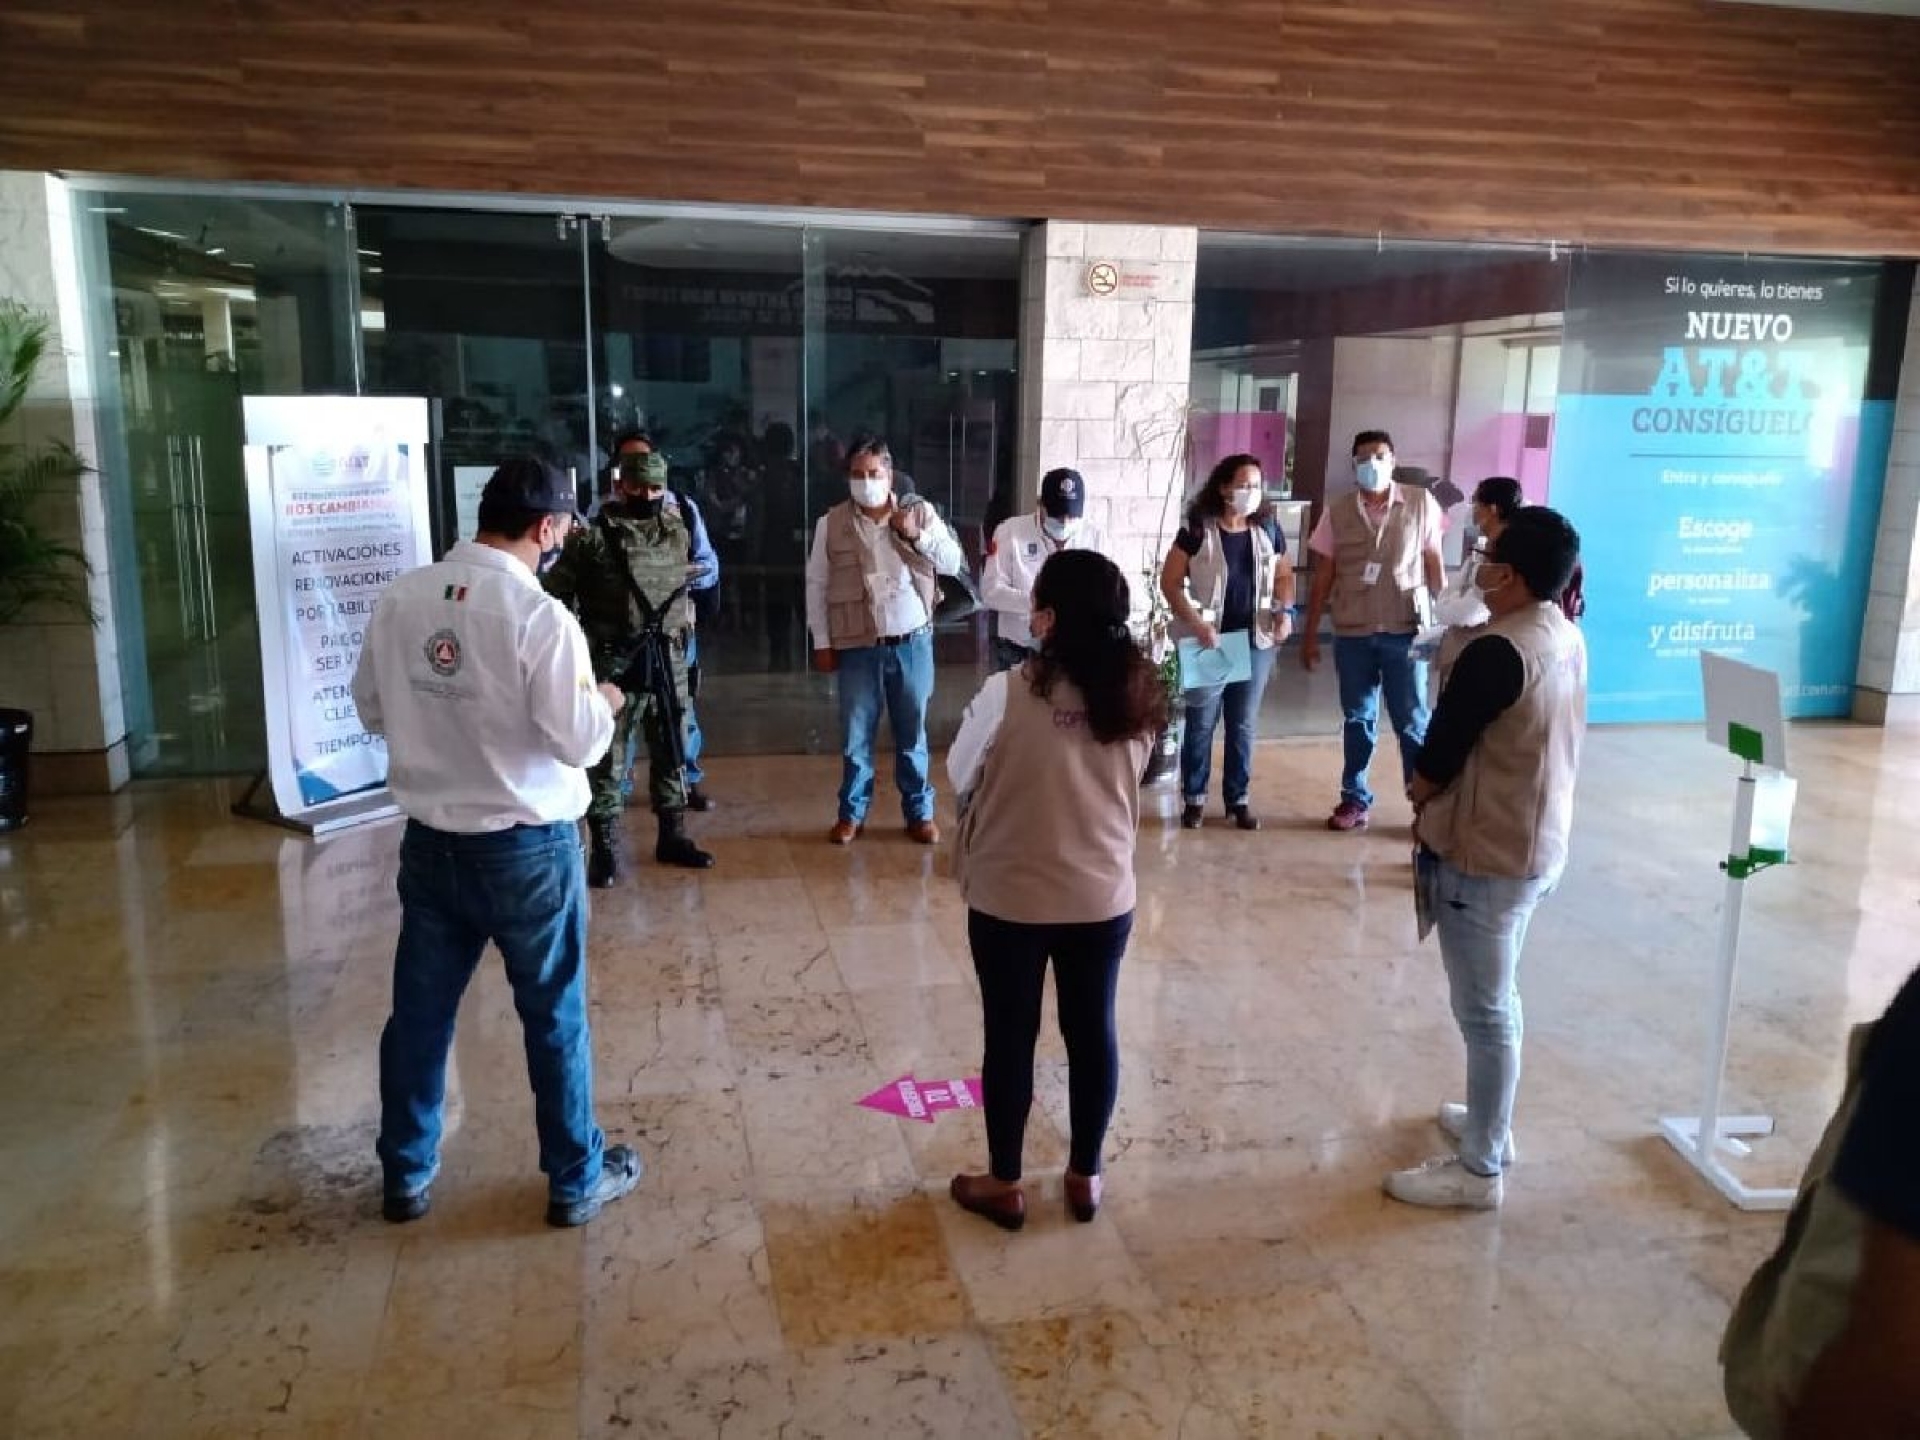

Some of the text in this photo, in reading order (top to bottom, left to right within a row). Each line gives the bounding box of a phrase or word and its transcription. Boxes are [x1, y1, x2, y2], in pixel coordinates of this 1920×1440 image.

[1664, 276, 1824, 300] Si lo quieres, lo tienes
[1685, 311, 1793, 342] NUEVO
[1650, 346, 1817, 398] AT&T
[1679, 516, 1753, 543] Escoge
[292, 541, 402, 566] ACTIVACIONES
[1647, 567, 1772, 597] personaliza
[295, 599, 378, 622] PORTABILI
[1649, 620, 1755, 648] y disfruta
[312, 684, 352, 704] ATEN
[324, 704, 357, 722] CLIE
[314, 732, 372, 755] TIEMPO
